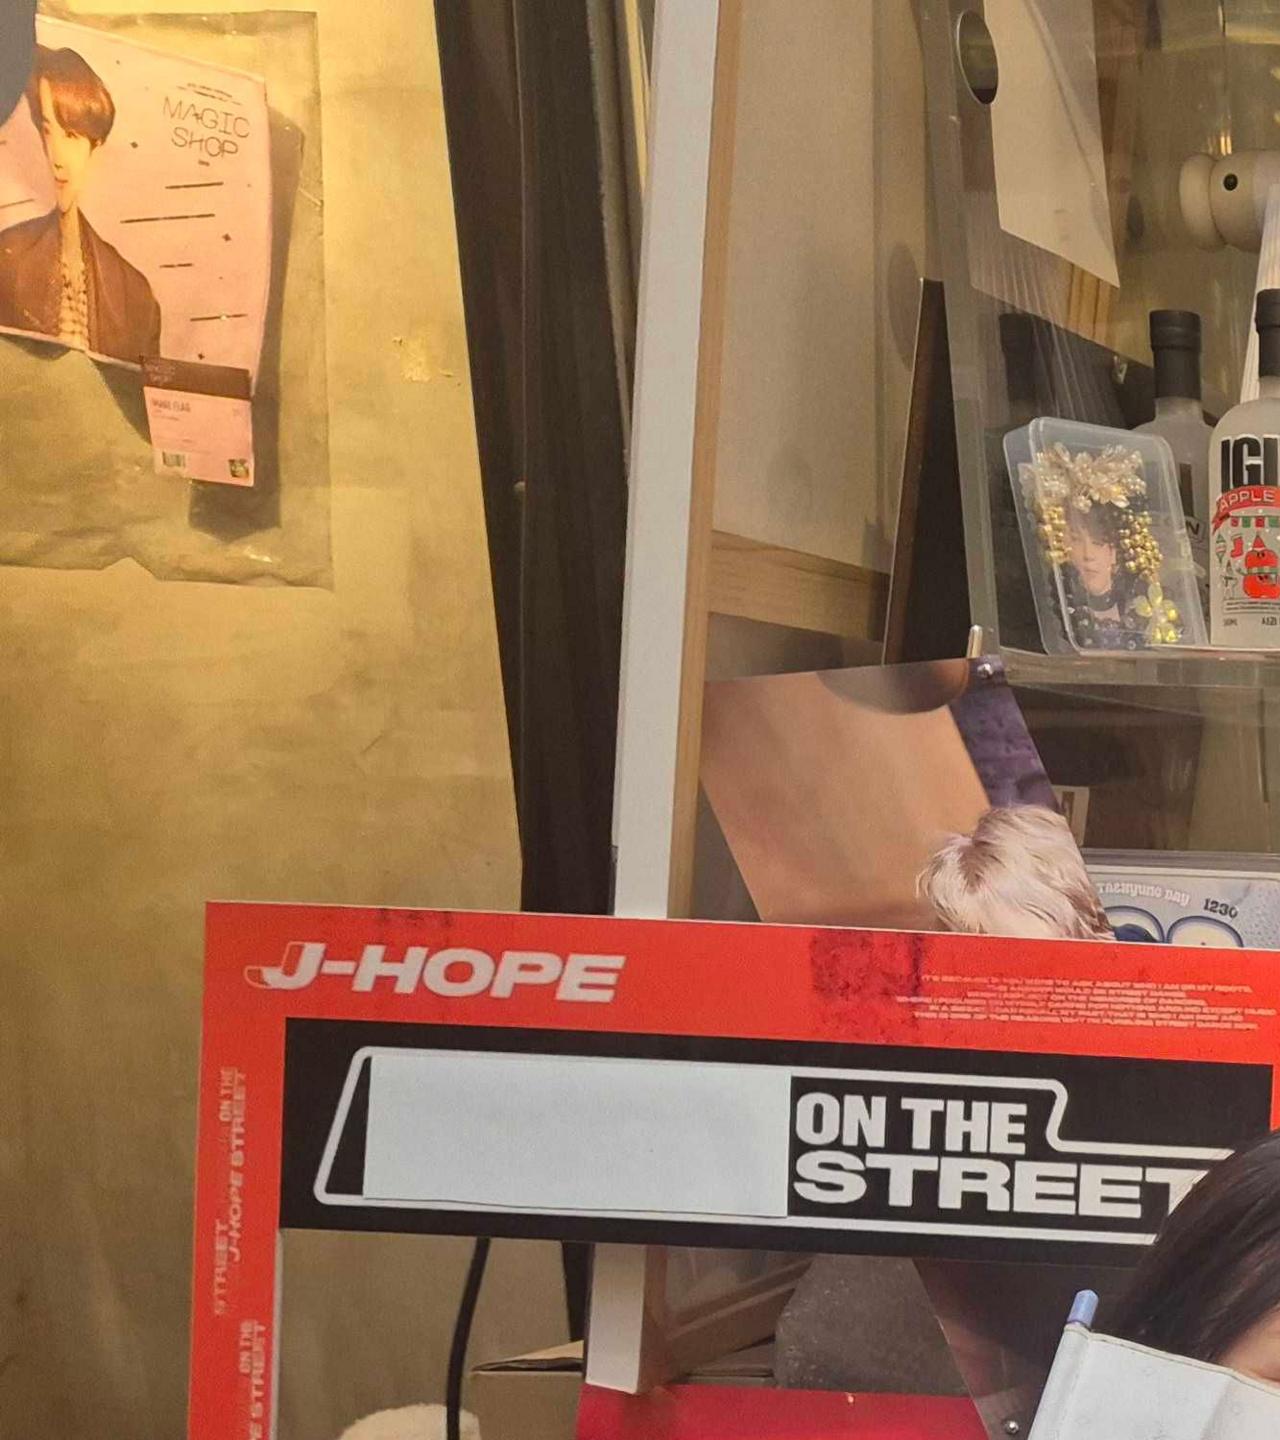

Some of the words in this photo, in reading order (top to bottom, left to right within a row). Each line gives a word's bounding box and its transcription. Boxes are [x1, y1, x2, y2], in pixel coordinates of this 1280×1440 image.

[162, 96, 250, 138] MAGIC
[171, 127, 238, 158] SHOP
[1220, 490, 1276, 512] APPLE
[1203, 898, 1239, 919] 1230
[247, 942, 626, 1003] J-HOPE
[230, 1067, 247, 1168] STREET
[795, 1092, 886, 1148] ON
[901, 1098, 1027, 1155] THE
[794, 1150, 1208, 1219] STREET
[227, 1170, 244, 1263] J-HOPE
[249, 1319, 267, 1419] STREET
